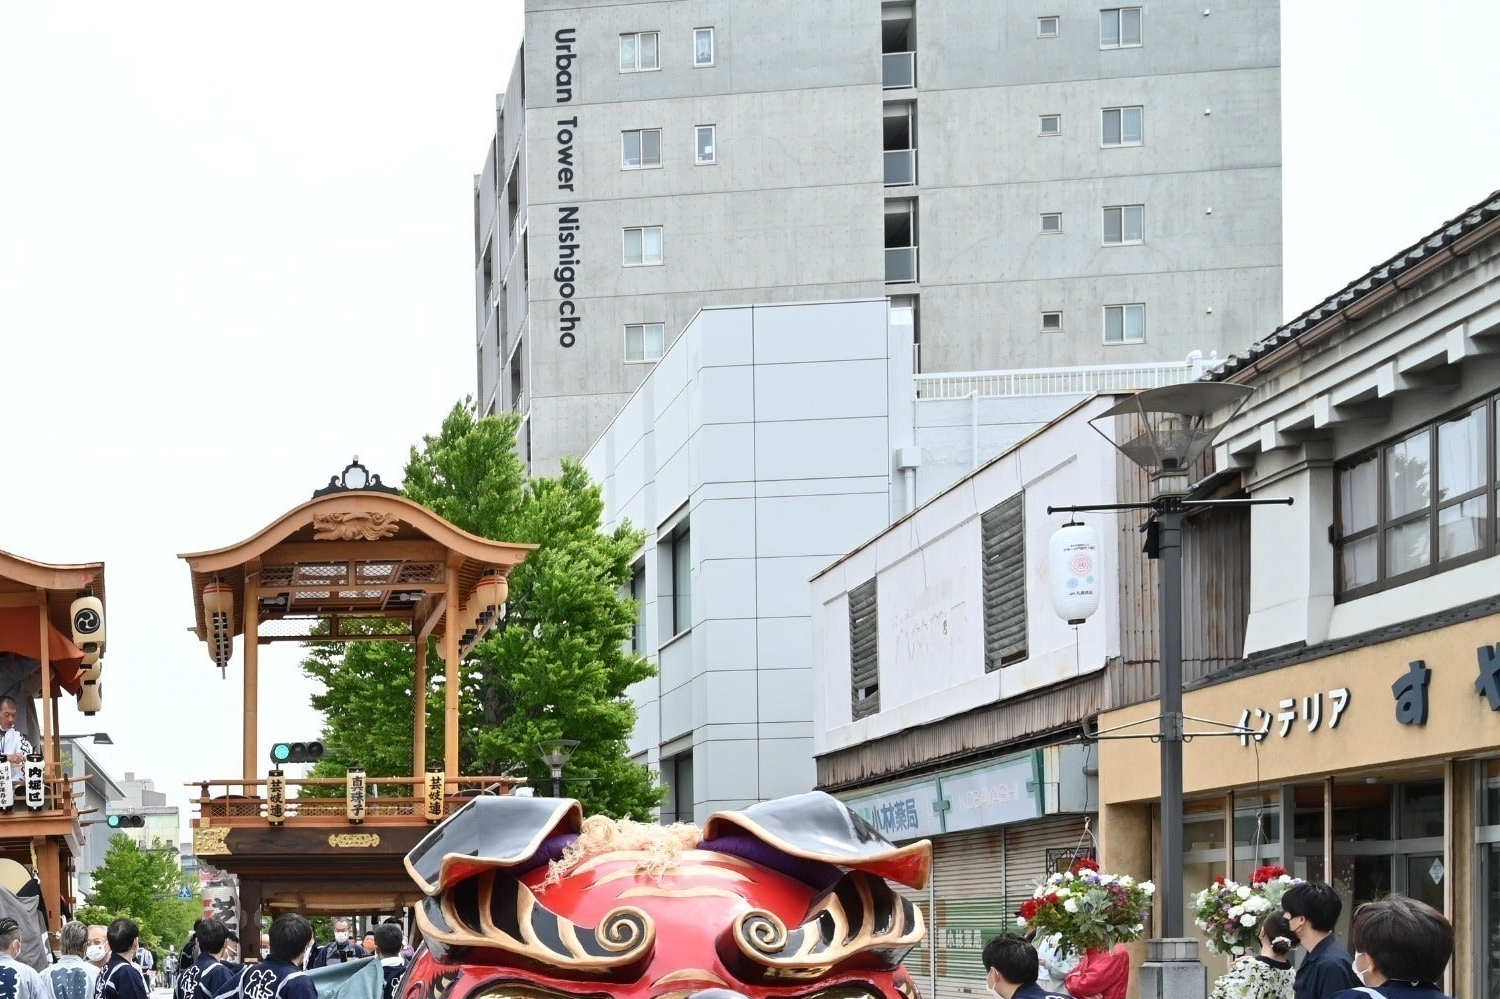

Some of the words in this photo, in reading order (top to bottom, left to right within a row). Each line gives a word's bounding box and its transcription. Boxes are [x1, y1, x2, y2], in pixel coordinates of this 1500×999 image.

[554, 27, 577, 103] Urban
[556, 116, 579, 193] Tower
[553, 206, 582, 349] Nishigocho
[1235, 687, 1350, 747] インテリア
[28, 766, 43, 802] 内堀区
[871, 798, 919, 834] 小林薬局
